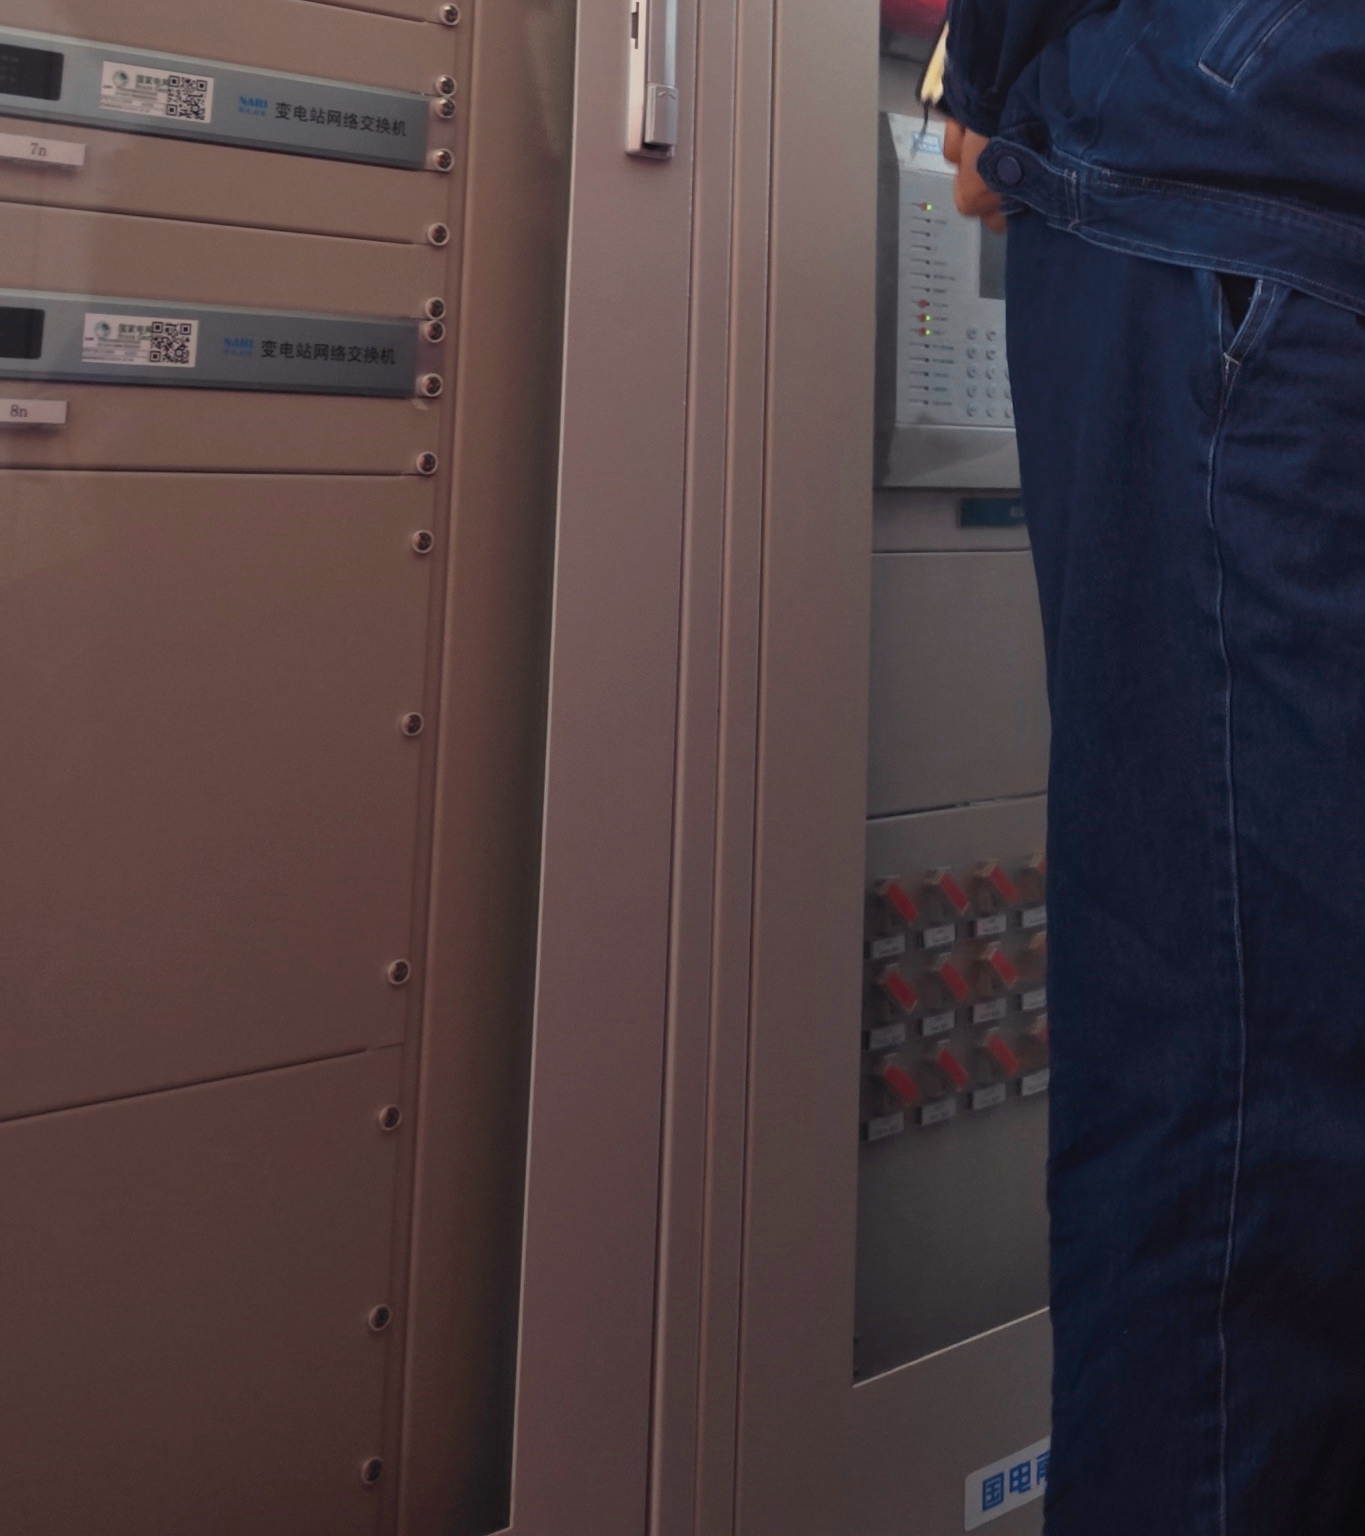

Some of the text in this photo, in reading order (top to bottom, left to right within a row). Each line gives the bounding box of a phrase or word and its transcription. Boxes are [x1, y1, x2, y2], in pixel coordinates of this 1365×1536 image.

[275, 101, 407, 137] 变电站网络交换机
[30, 142, 47, 157] 7n
[261, 340, 396, 365] 变电站网络交换机
[10, 404, 28, 419] 8n
